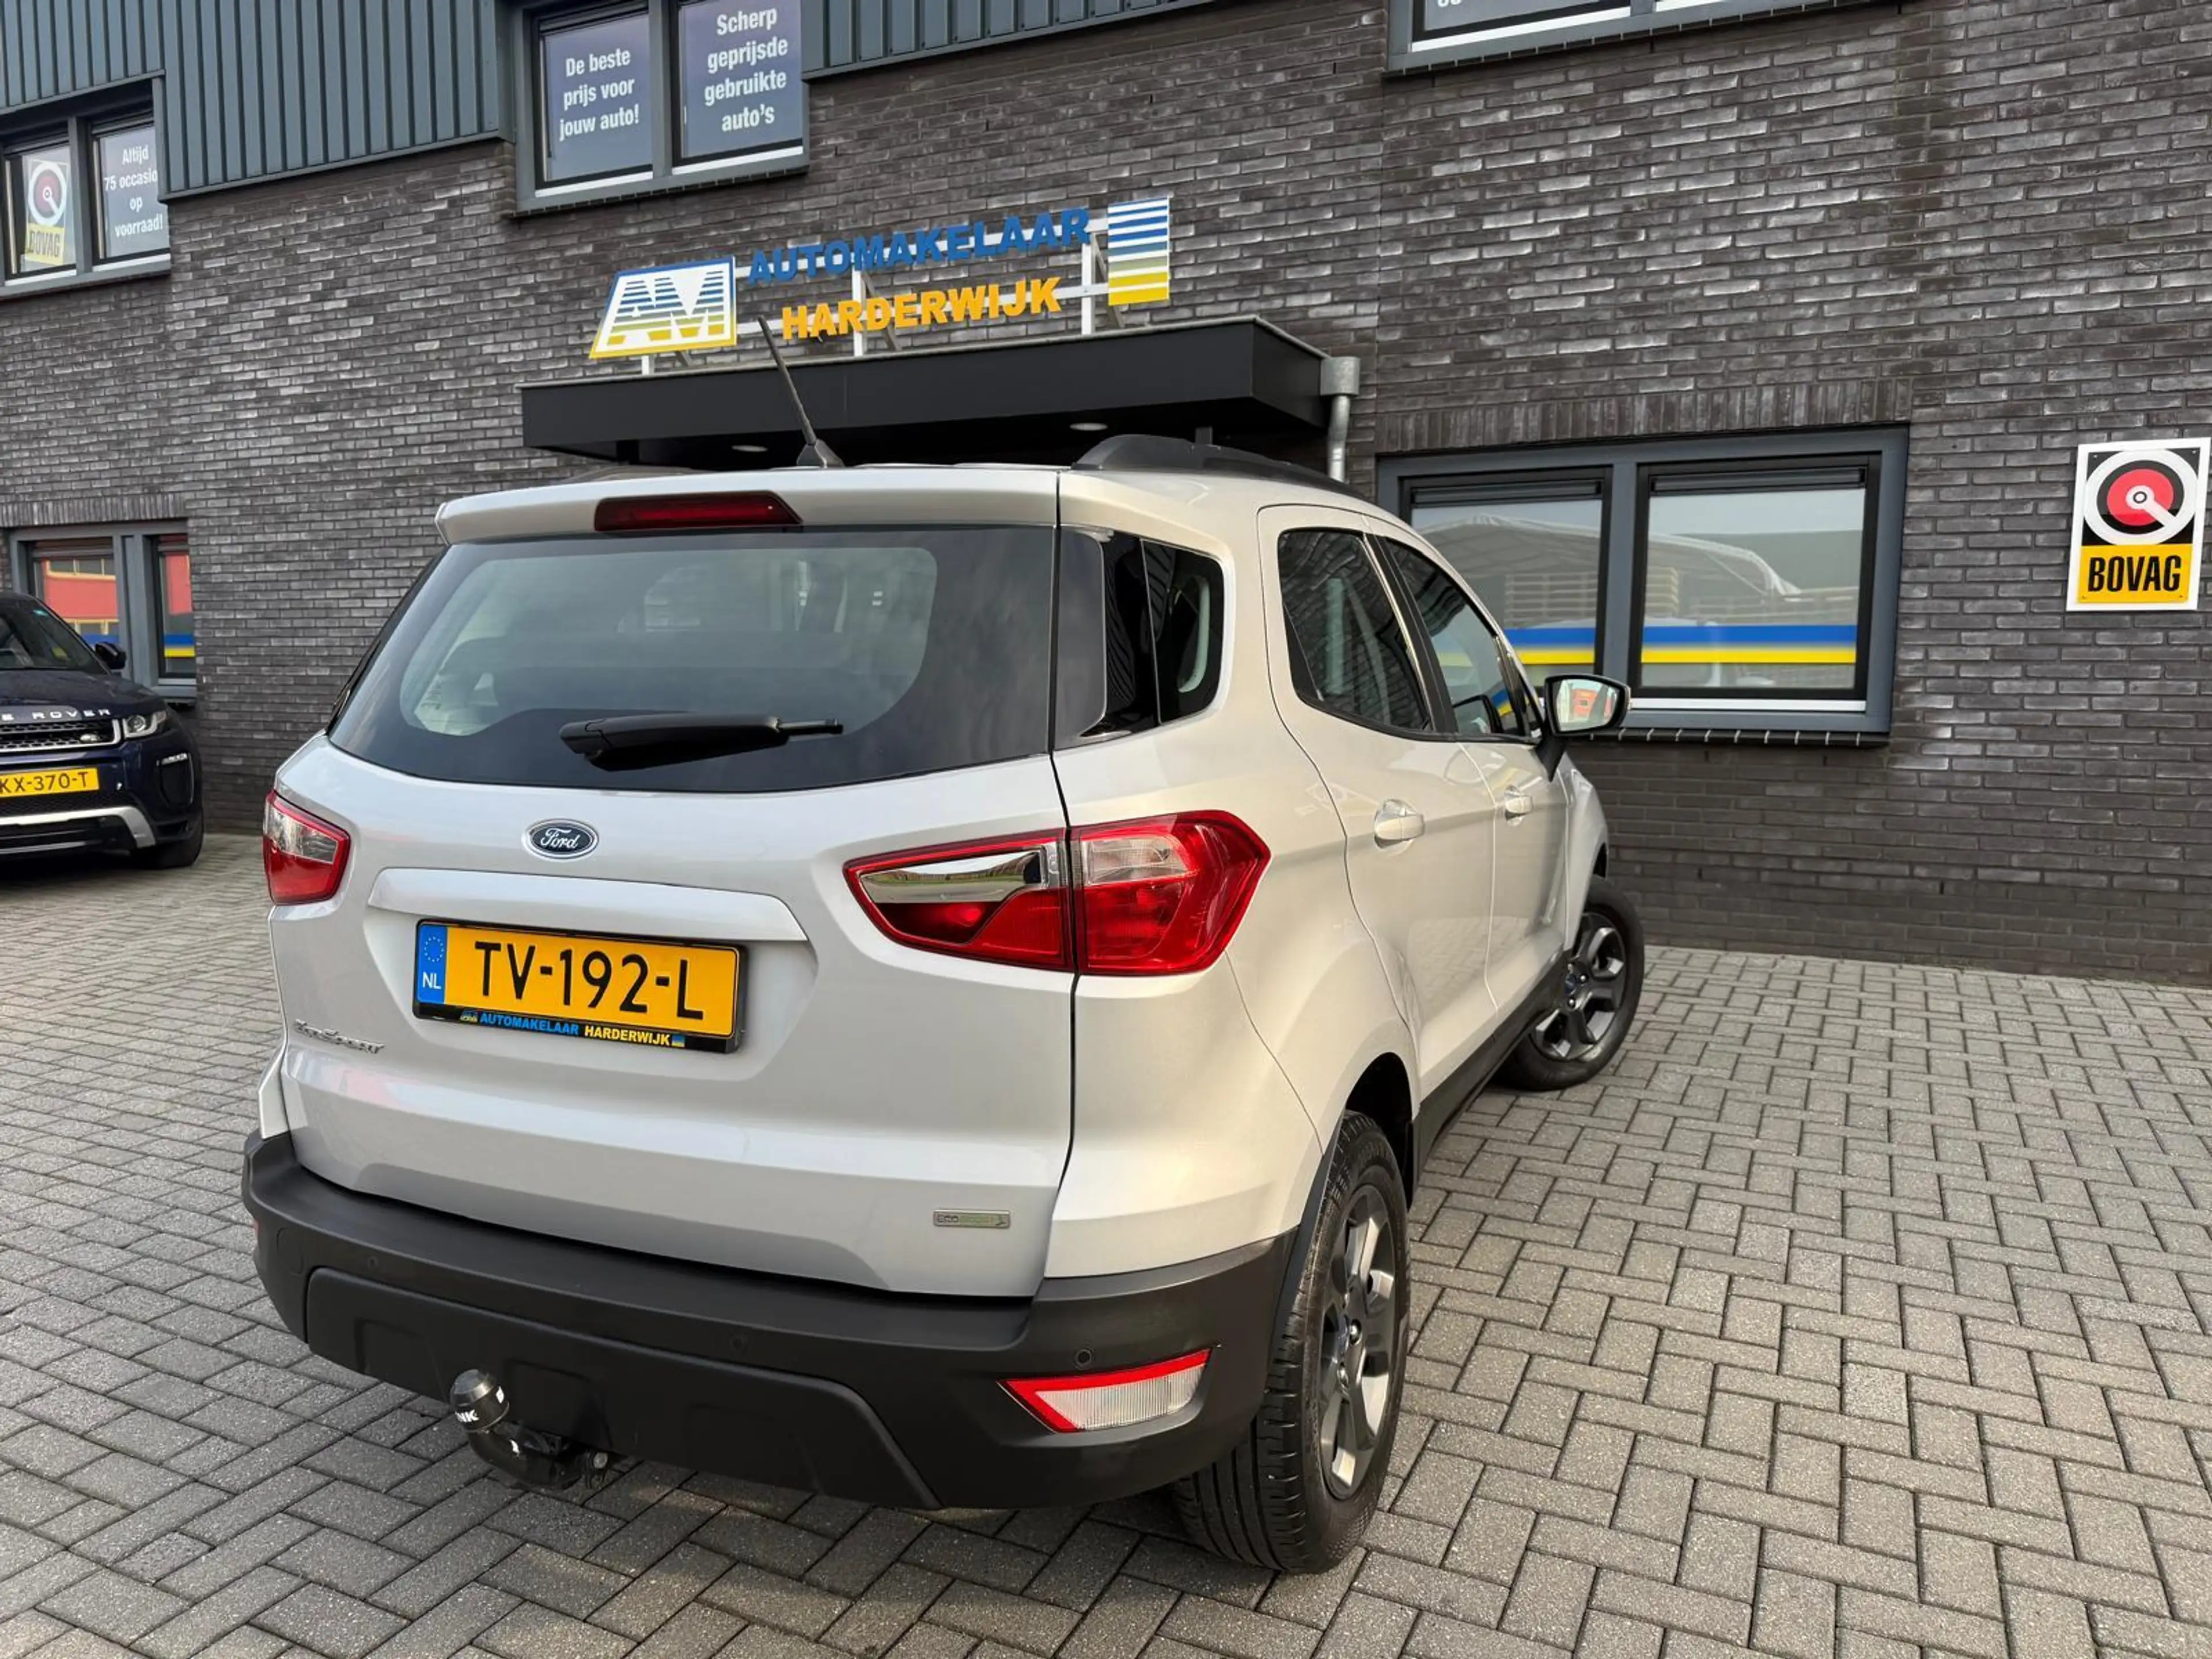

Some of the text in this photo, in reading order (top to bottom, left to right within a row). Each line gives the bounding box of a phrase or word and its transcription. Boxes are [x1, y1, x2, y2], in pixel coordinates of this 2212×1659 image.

[717, 8, 778, 35] Scherp
[565, 48, 631, 77] De beste
[707, 36, 788, 74] geprijsde
[564, 78, 635, 111] prijs voor
[704, 69, 787, 107] gebruikte
[559, 103, 639, 142] jouw auto!
[721, 104, 775, 132] auto's
[122, 145, 149, 165] Altijd
[104, 168, 158, 191] 75 occasio
[130, 196, 143, 213] op
[115, 214, 163, 237] voorraad!
[749, 207, 1090, 285] AUTOMAKELAAR
[782, 276, 1062, 339] HARDERWIJK
[2088, 555, 2182, 593] BOVAG
[32, 709, 111, 719] ROVER
[540, 828, 580, 849] Ford
[422, 971, 441, 990] NL
[475, 941, 703, 1020] TV-192-L
[480, 1013, 579, 1036] AUTOMAKELAAR
[585, 1025, 671, 1047] HARDERWIJK
